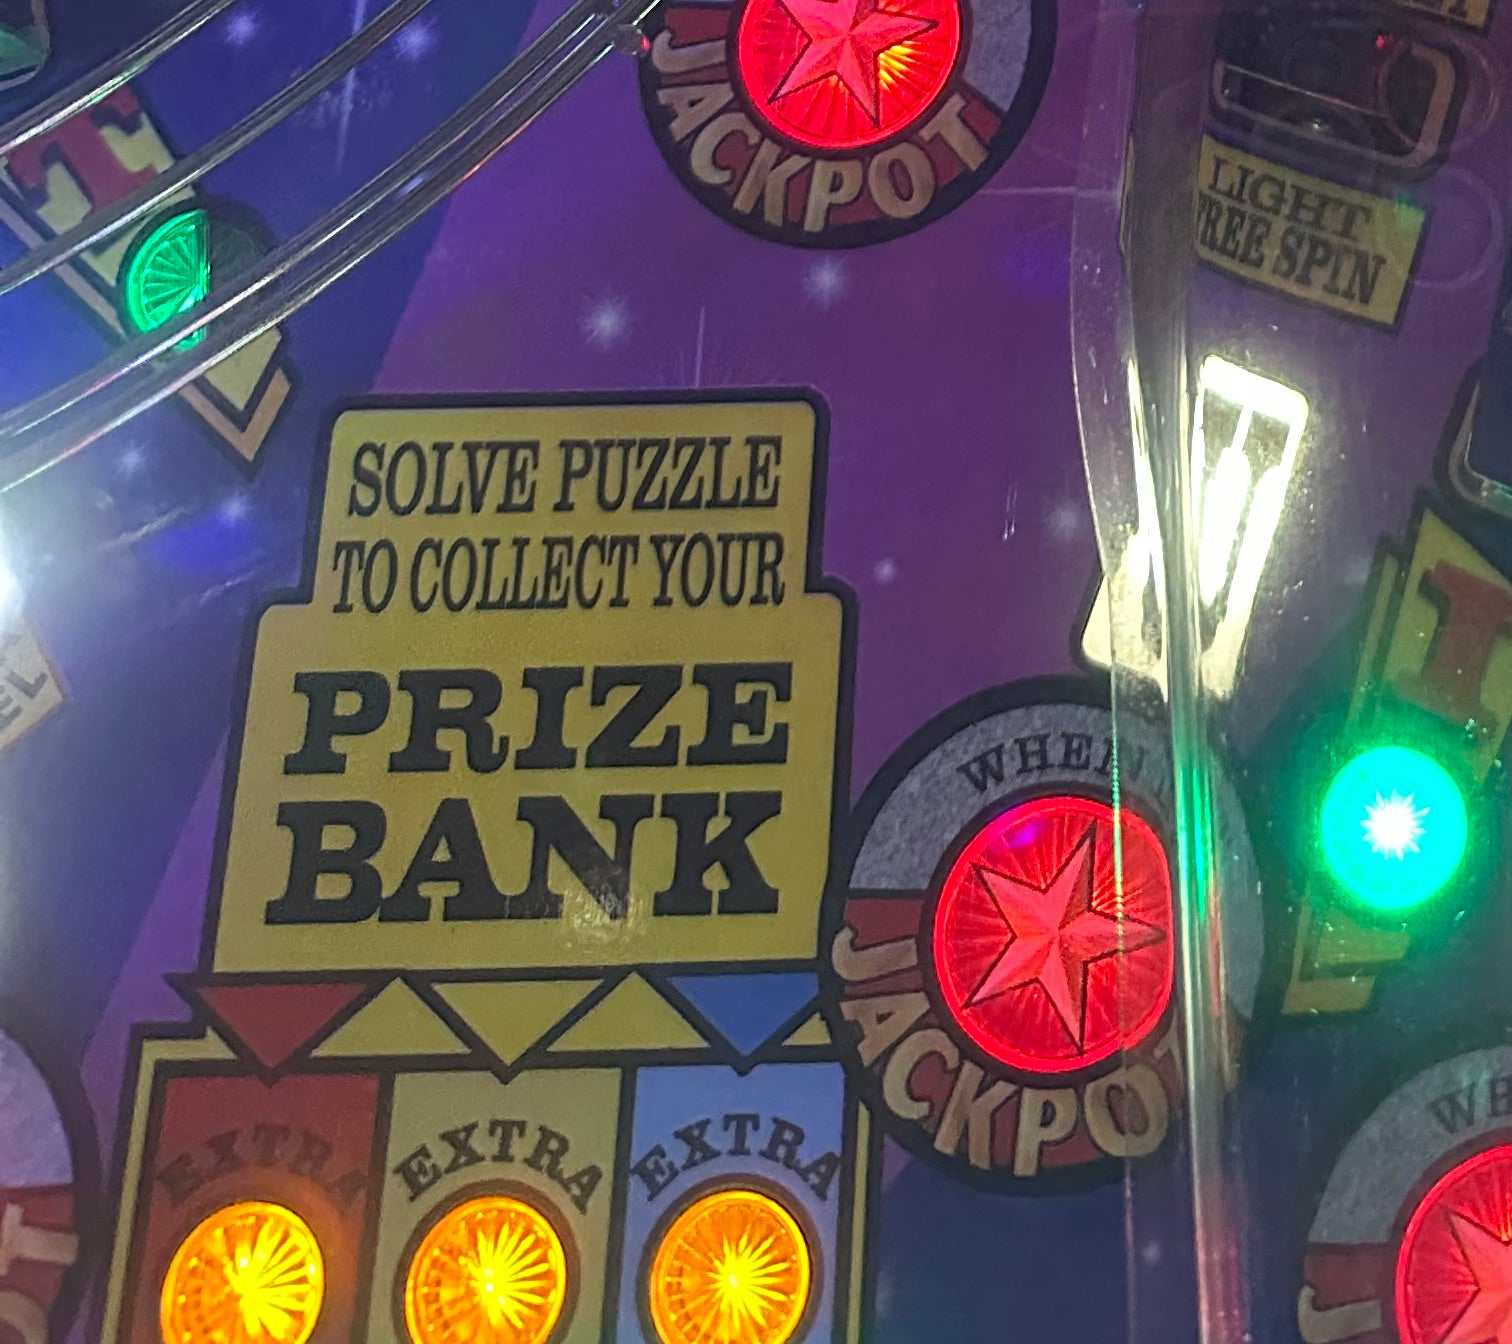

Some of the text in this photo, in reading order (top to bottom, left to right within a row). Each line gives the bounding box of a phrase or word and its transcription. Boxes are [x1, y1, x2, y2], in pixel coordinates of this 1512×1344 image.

[650, 26, 993, 234] JACKPOT
[1207, 155, 1374, 242] LIGHT
[1199, 195, 1387, 307] REE SPIN
[347, 435, 783, 518] SOLVE PUZZLE
[332, 531, 787, 614] TO COLLECT YOUR
[282, 660, 794, 776] PRIZE
[263, 791, 783, 926] BANK
[156, 1122, 370, 1216] EXTRA
[394, 1118, 606, 1215] EXTRA
[628, 1113, 841, 1203] EXTRA
